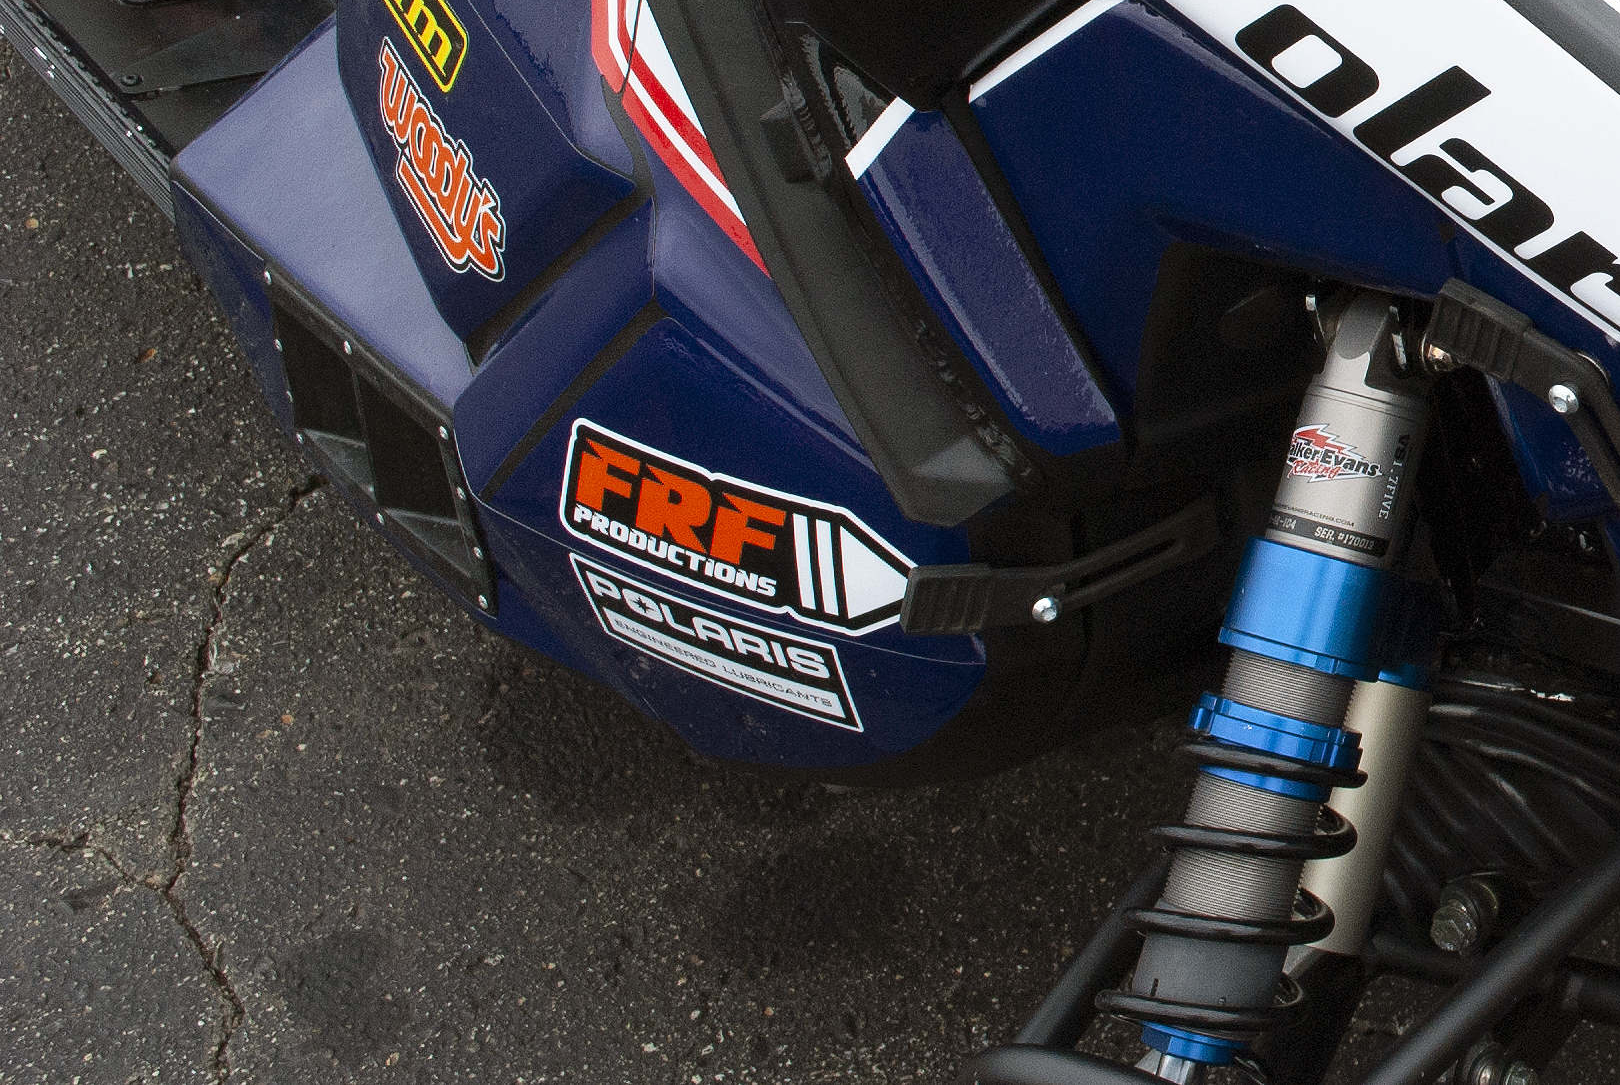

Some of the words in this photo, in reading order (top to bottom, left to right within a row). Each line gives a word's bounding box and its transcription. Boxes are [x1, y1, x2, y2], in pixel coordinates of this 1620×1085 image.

[575, 438, 787, 566] FRF
[1320, 448, 1381, 477] Evans
[573, 503, 778, 598] PRODUCTIONS
[1314, 526, 1335, 541] SER.
[586, 570, 830, 680] POLARIS
[614, 618, 718, 669] ENGINEERED
[722, 665, 834, 708] LUBRICANTS
